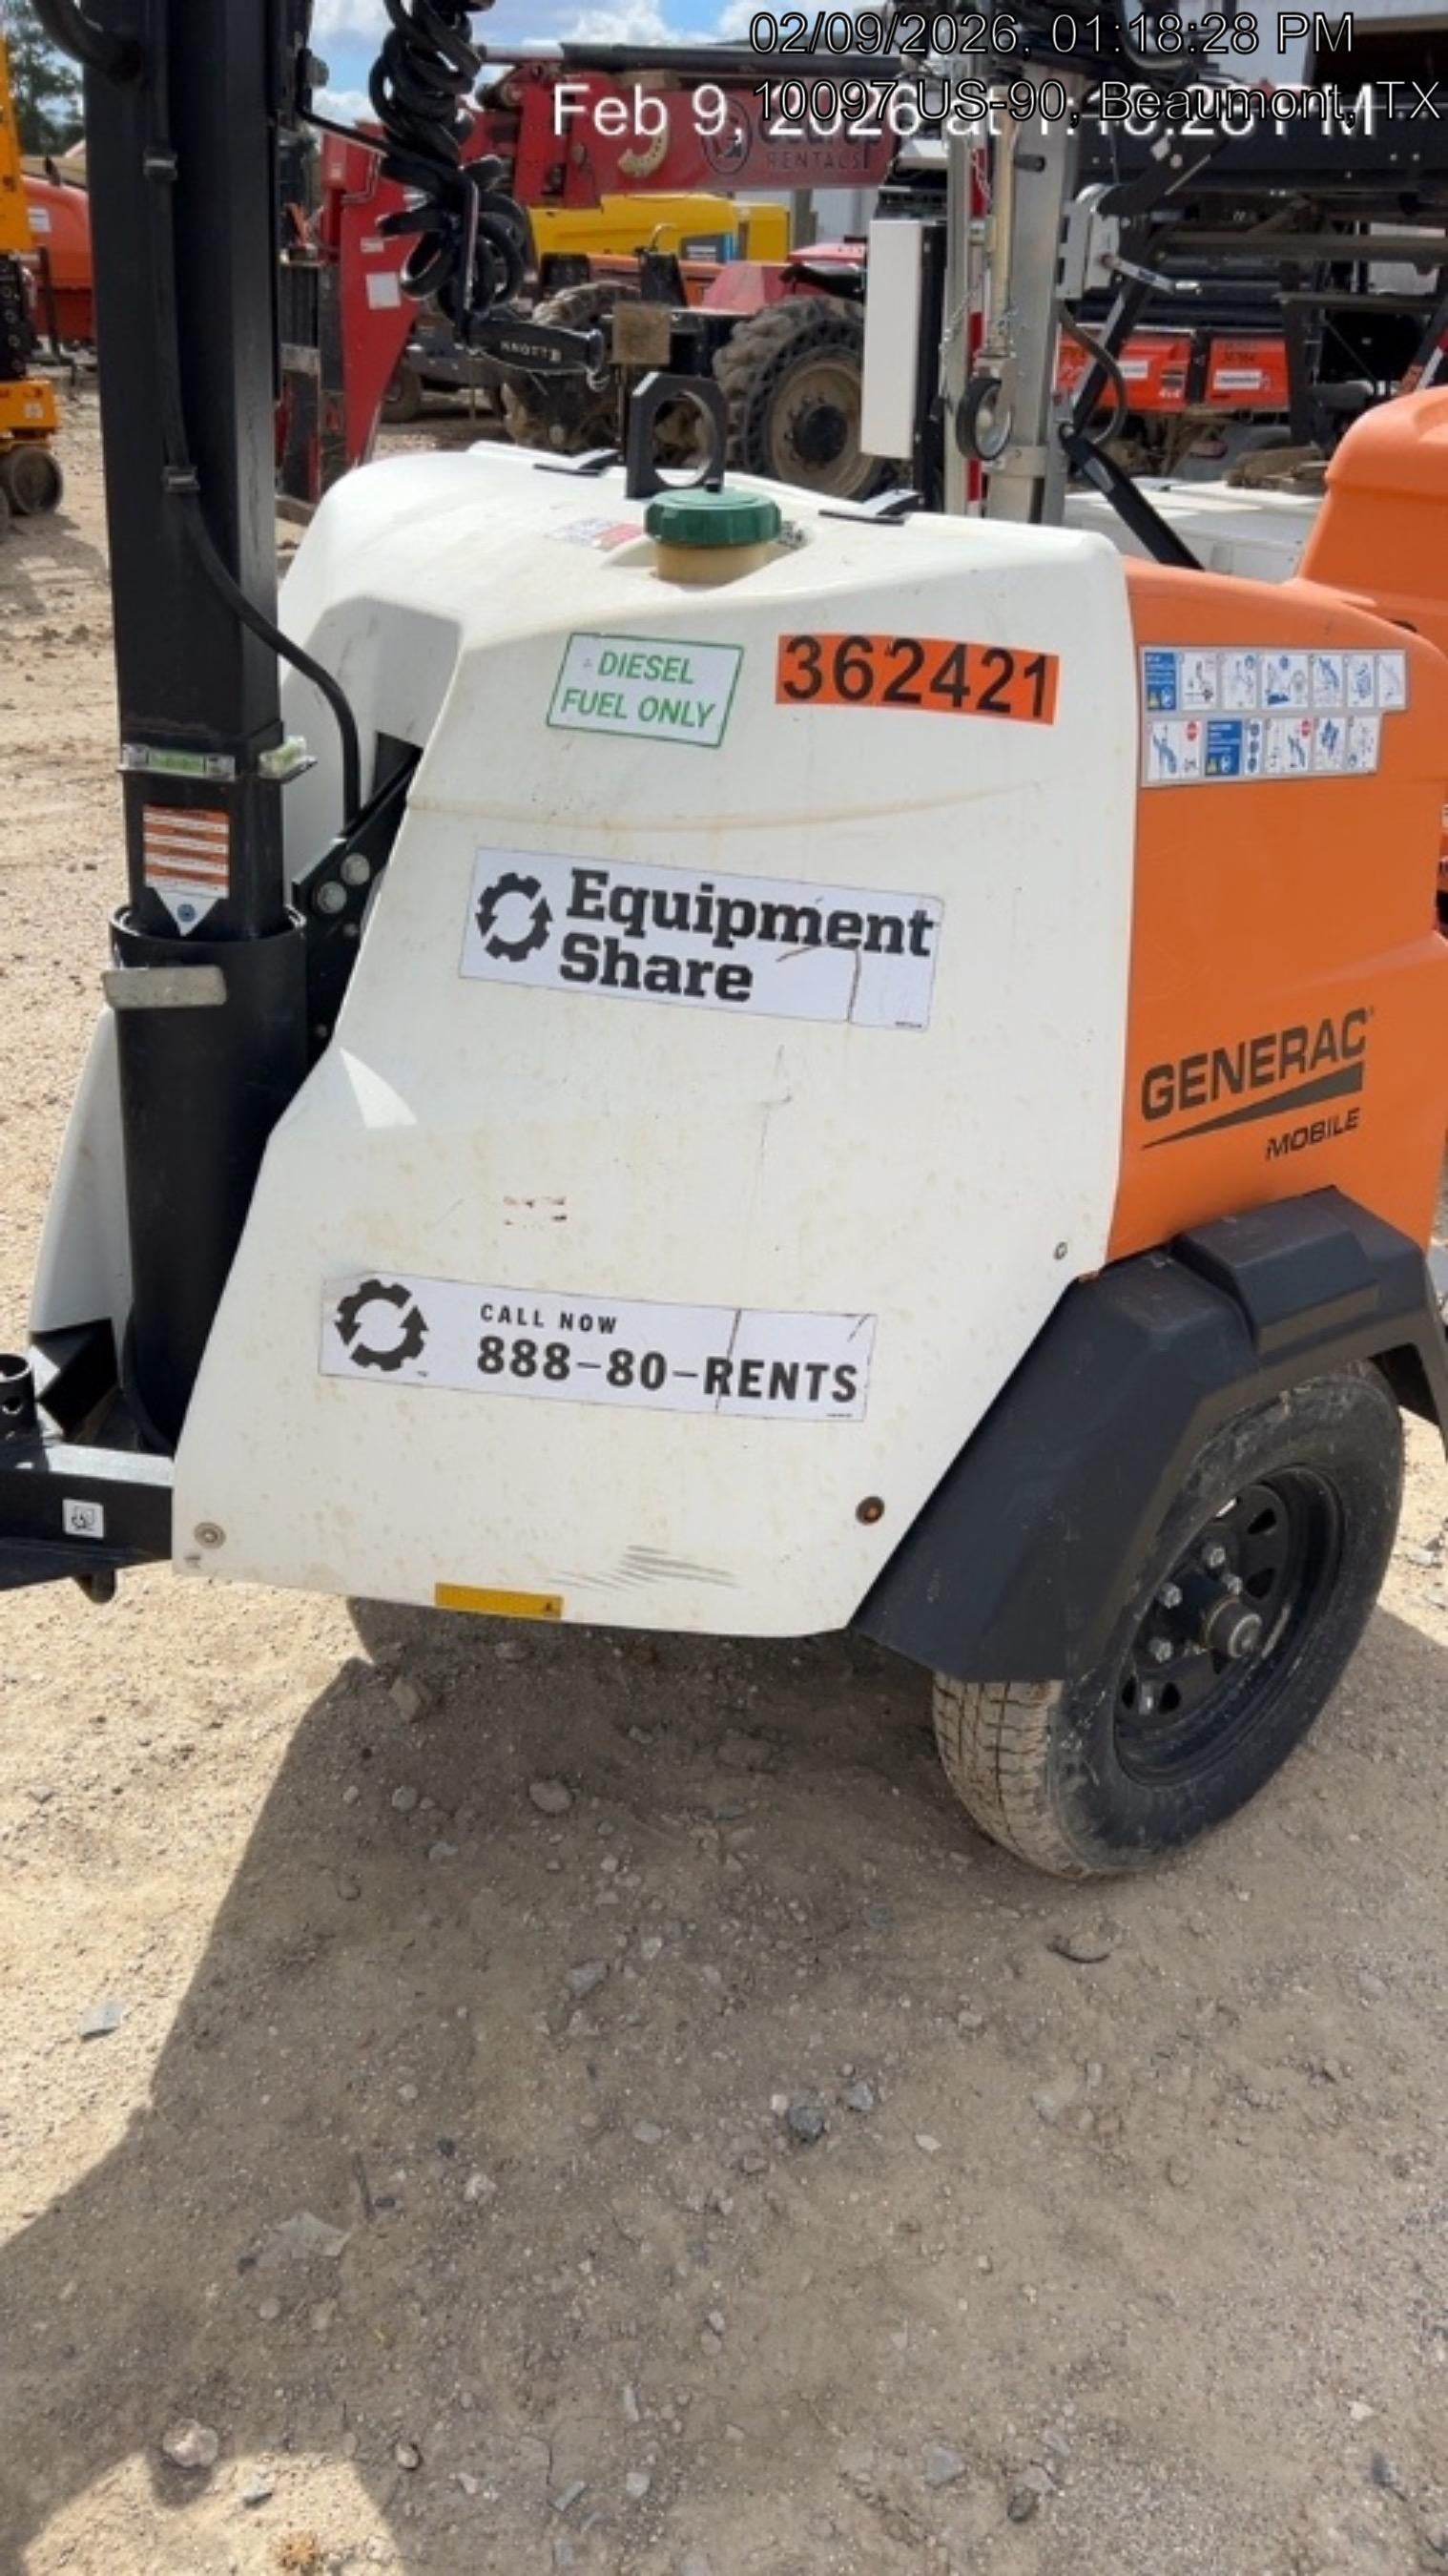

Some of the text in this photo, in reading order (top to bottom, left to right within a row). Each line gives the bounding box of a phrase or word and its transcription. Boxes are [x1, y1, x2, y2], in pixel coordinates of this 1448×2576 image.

[597, 652, 693, 685] DIESEL
[783, 635, 1047, 718] 362421
[560, 690, 716, 728] FUEL ONLY
[566, 867, 936, 957] Equipment
[559, 932, 753, 1003] Share
[1141, 1008, 1368, 1122] GENERAC
[1264, 1107, 1361, 1161] MOBILE
[479, 1303, 618, 1335] CALL NOW
